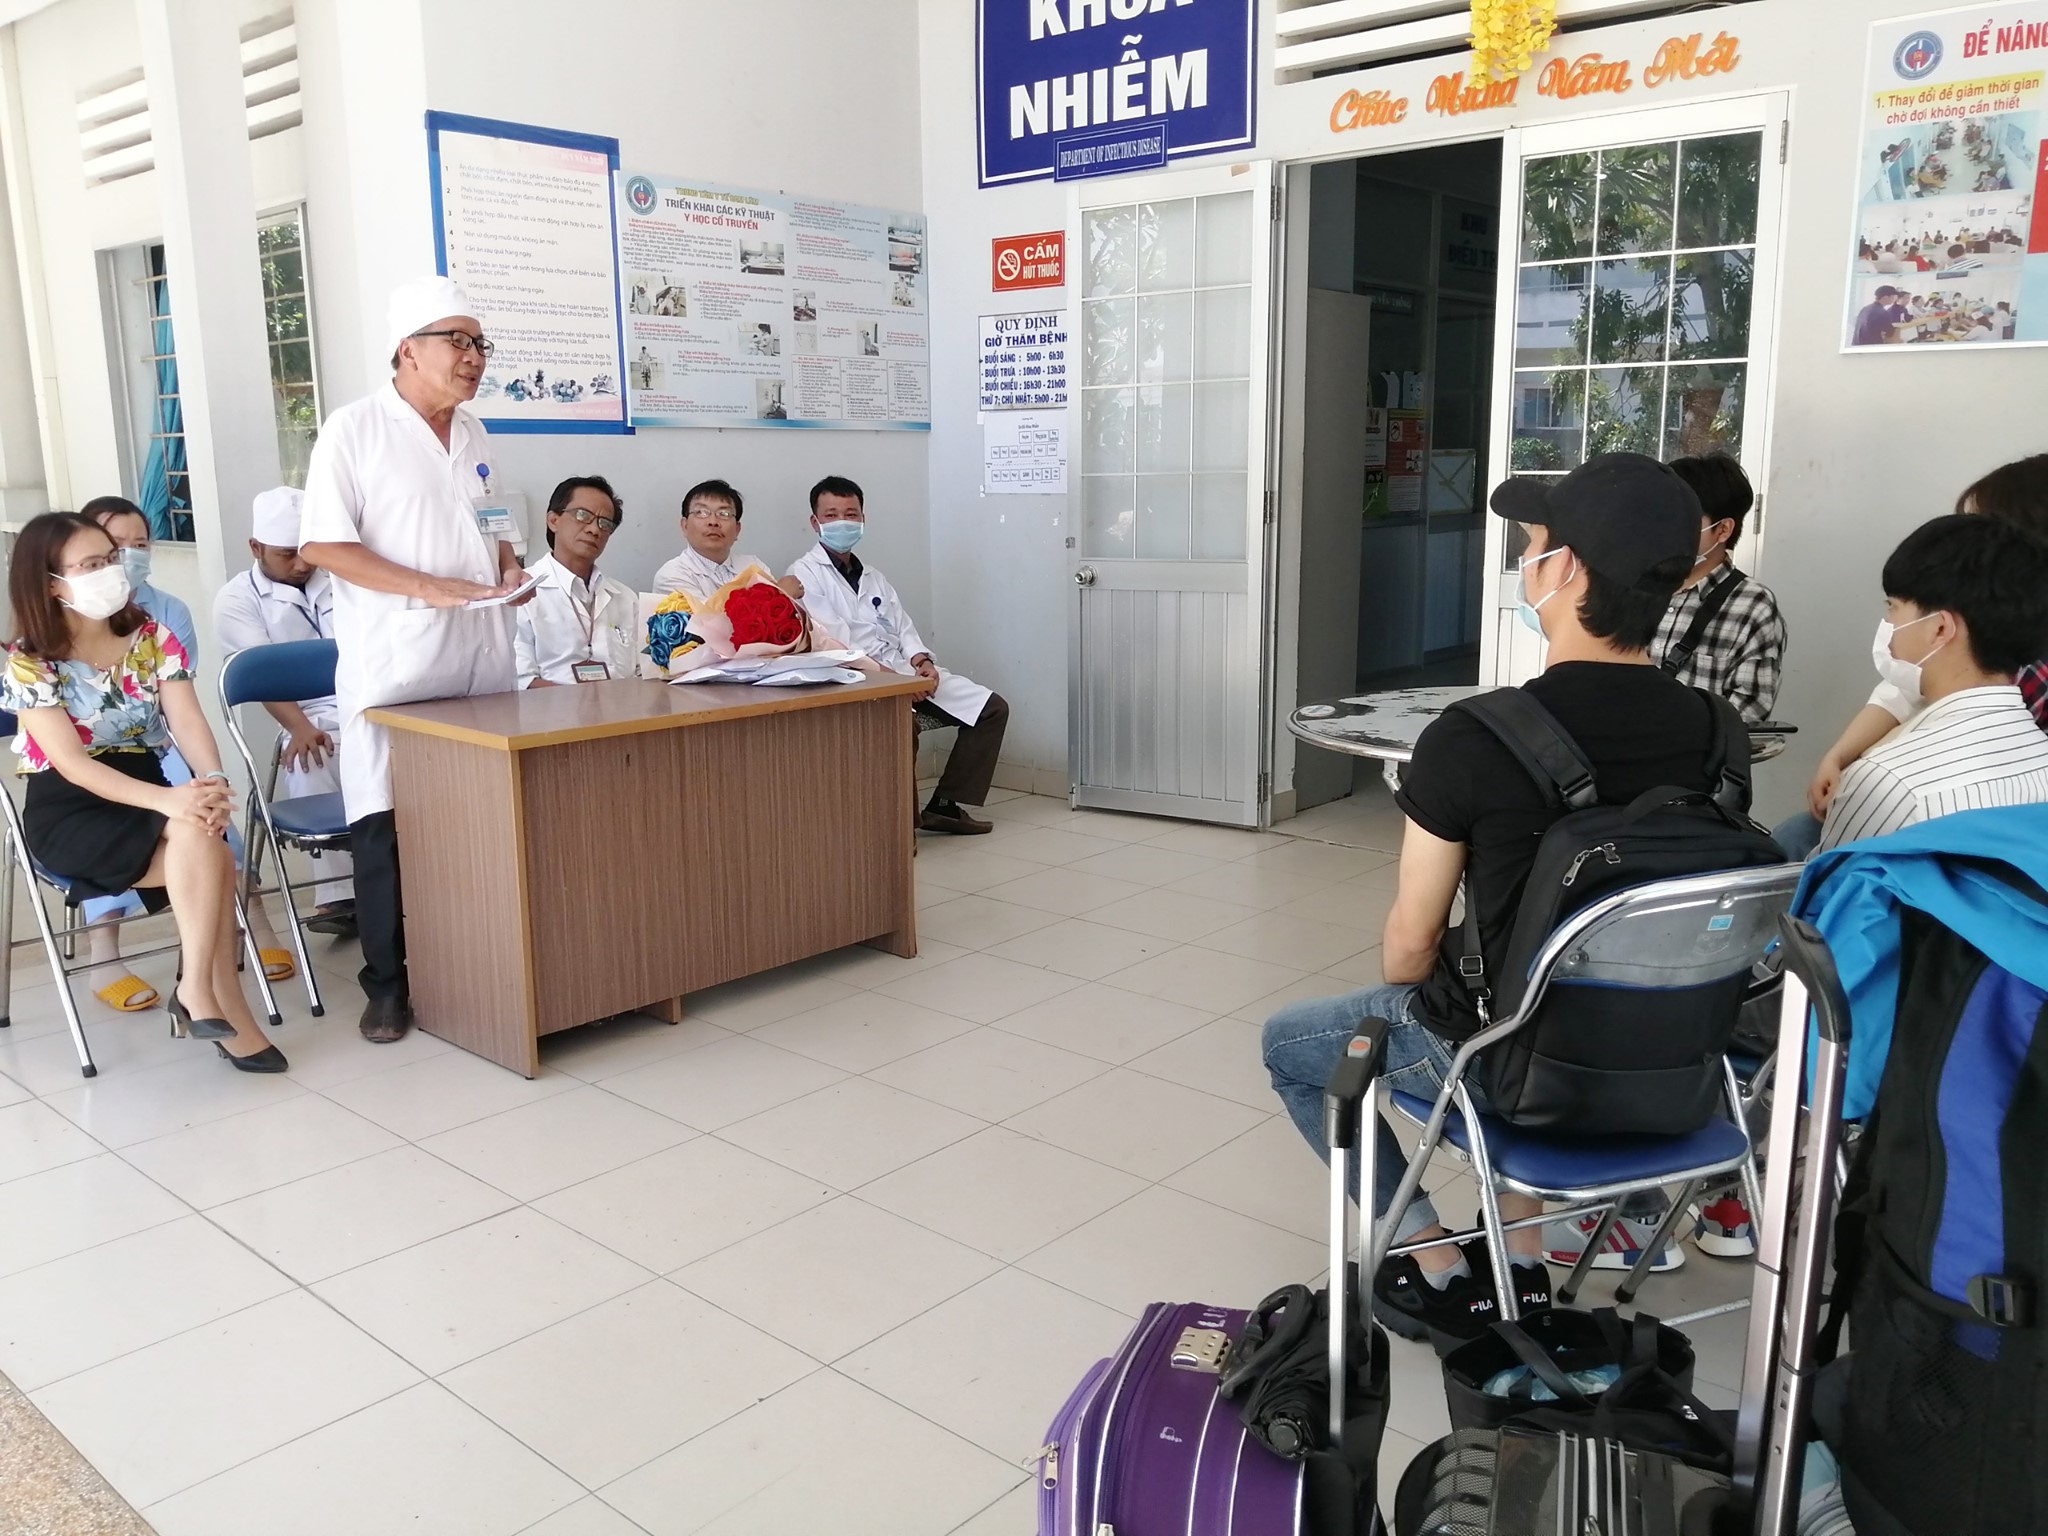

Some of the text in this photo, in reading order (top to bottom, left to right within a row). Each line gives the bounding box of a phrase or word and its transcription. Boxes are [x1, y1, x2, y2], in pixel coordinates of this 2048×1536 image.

[1029, 0, 1193, 41] KH
[1963, 18, 1993, 59] ĐỂ
[1010, 33, 1208, 140] NHIỄM
[1329, 88, 1408, 134] Chúc
[1537, 53, 1632, 99] Năm
[1643, 31, 1741, 89] Mới
[1876, 78, 2040, 109] 1. Thay đổi để giảm thời gian
[1886, 95, 2020, 124] chờ đợi không cần thiết
[1060, 136, 1161, 168] DEPARTMENT OF INFECTIOUS DISEASE
[664, 197, 692, 210] TRIỂN
[693, 202, 714, 213] KHAI
[715, 204, 734, 215] CÁC
[735, 205, 747, 218] KỸ
[748, 209, 775, 222] THUẬT
[684, 213, 758, 231] Y HỌC CỔ TRUYỀN
[1023, 239, 1059, 260] CẤM
[1023, 259, 1060, 279] HÚT THUỐC
[995, 315, 1058, 333] QUY ĐỊNH
[985, 330, 1068, 347] GIỜ THĂM BỆNH
[984, 350, 1064, 364] BUỔI SÁNG 5h00 6h30
[984, 364, 1066, 378] BUỔI TRƯA 10h00 13h30
[984, 377, 1066, 391] BUỔI CHIỀU 16h30 21h00
[981, 394, 993, 405] THỨ
[1001, 392, 1014, 405] CHỦ
[1034, 394, 1050, 403] 5h00
[1470, 1298, 1494, 1313] FILA
[1522, 1292, 1548, 1303] FILA
